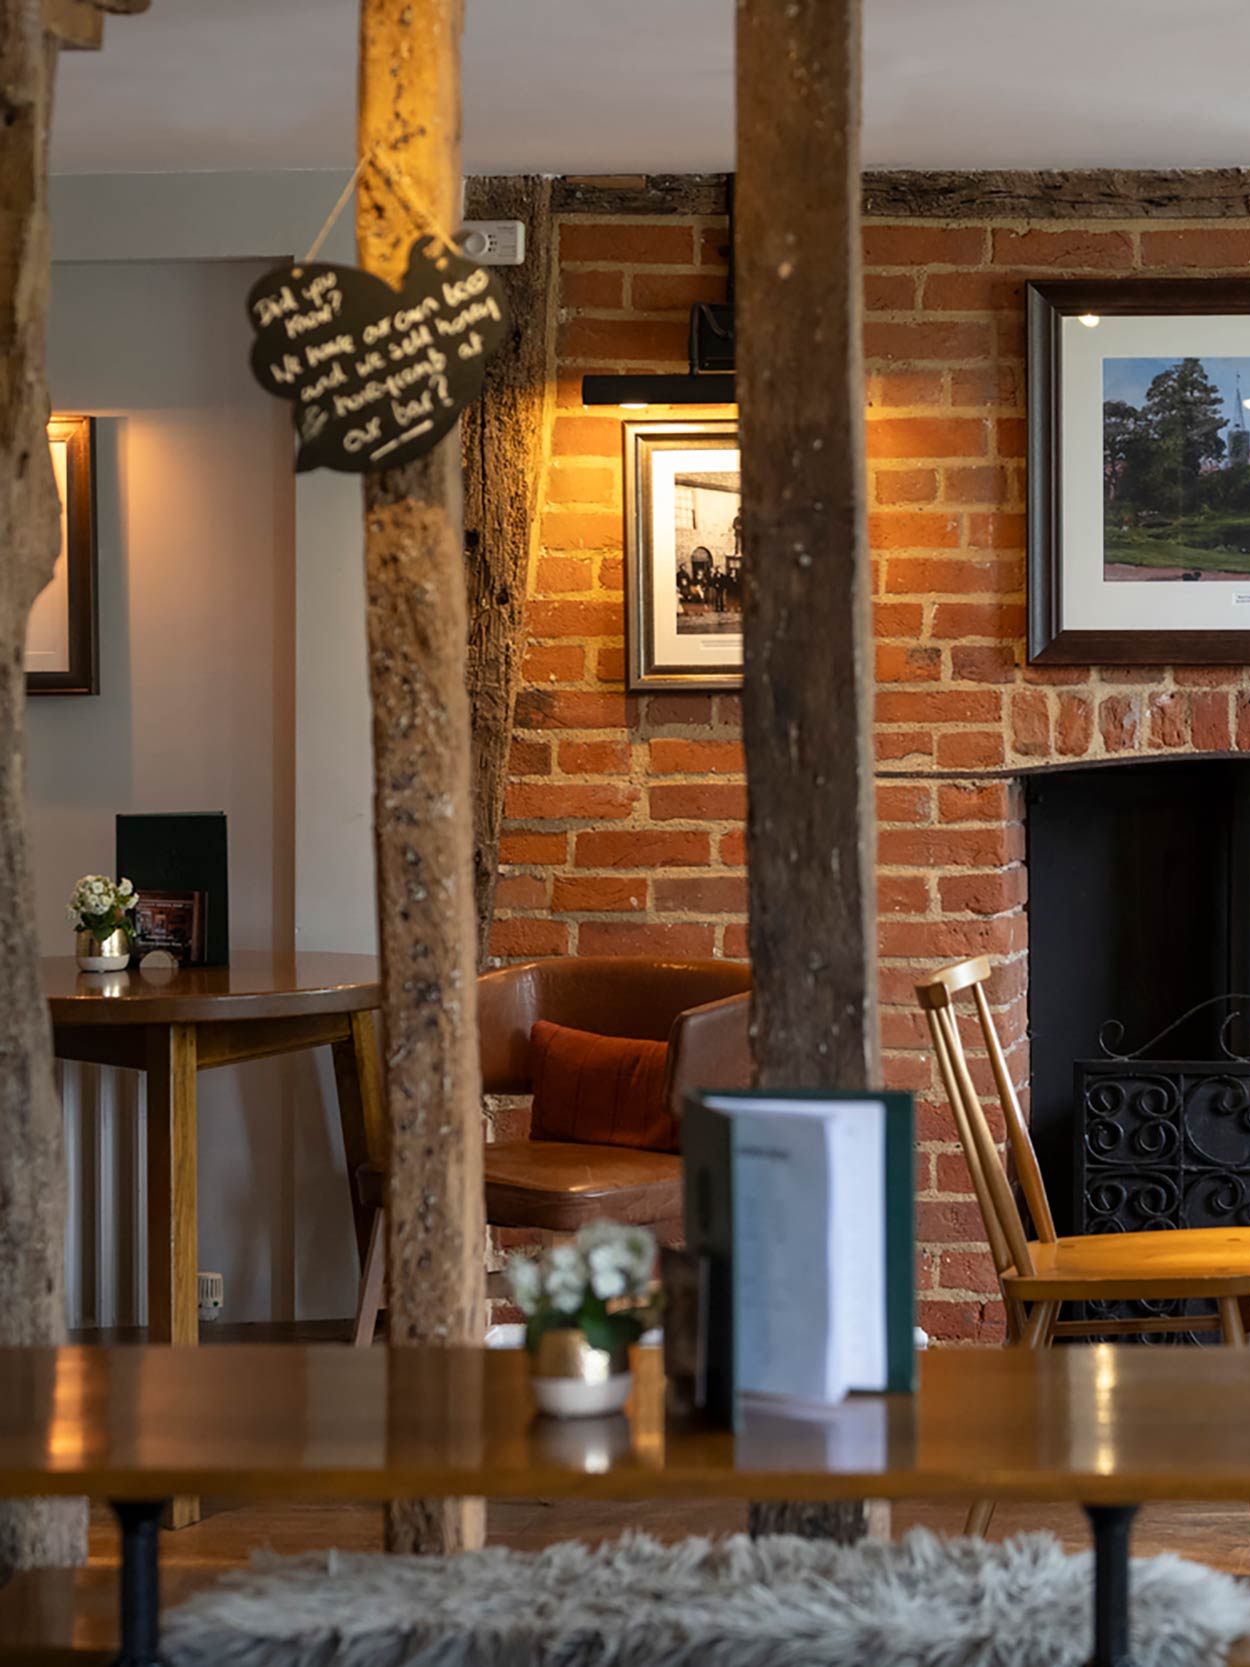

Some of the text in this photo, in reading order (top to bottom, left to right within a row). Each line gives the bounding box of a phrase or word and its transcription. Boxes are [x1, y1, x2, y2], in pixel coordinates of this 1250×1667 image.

[301, 361, 348, 401] and
[388, 325, 433, 360] sell
[434, 296, 501, 336] honey
[305, 334, 355, 368] have
[362, 316, 391, 345] our
[458, 331, 483, 359] at
